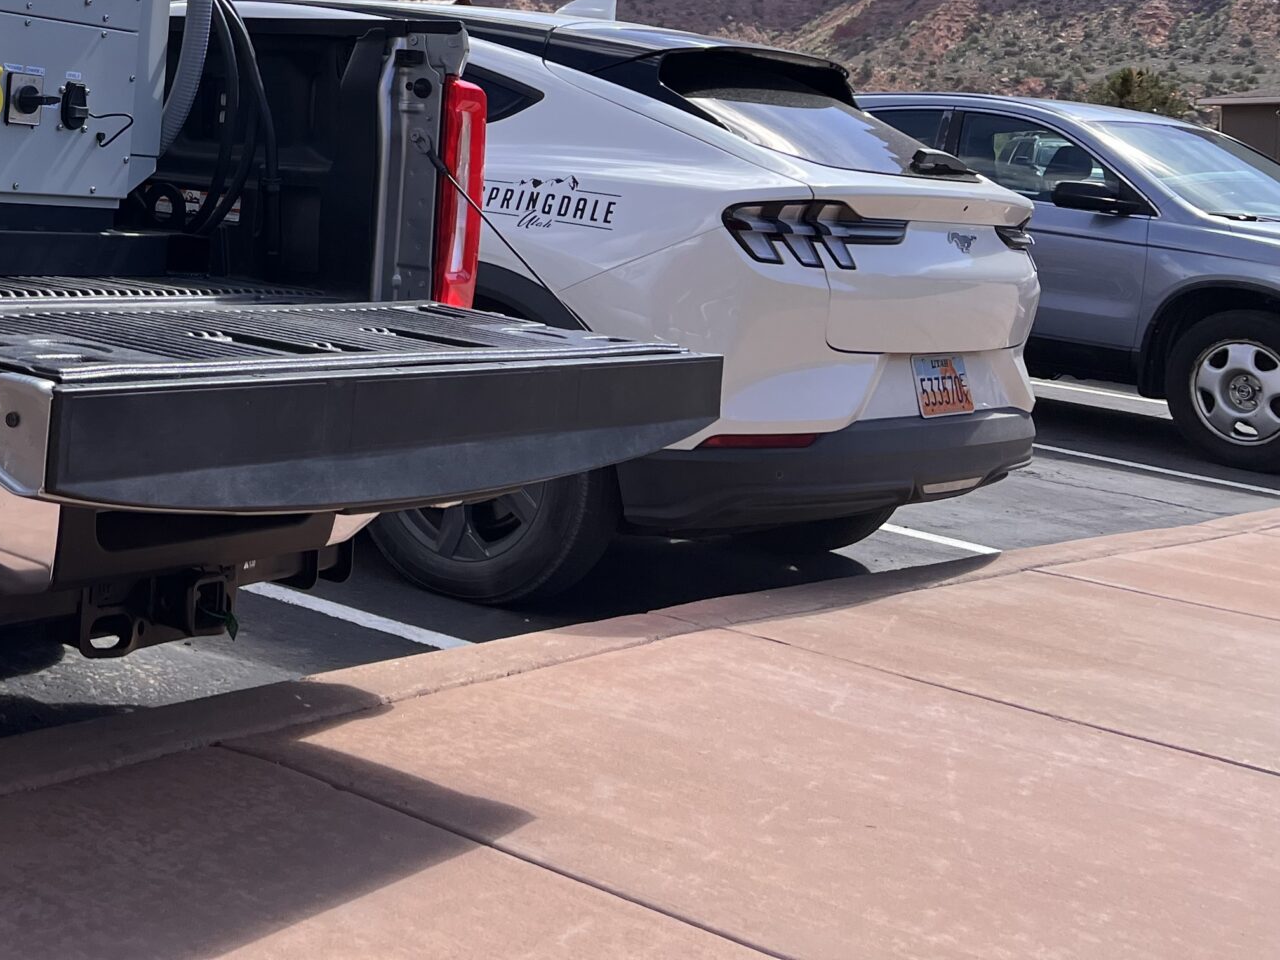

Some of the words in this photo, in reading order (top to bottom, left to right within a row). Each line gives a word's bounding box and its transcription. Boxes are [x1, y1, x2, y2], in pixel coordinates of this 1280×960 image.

[483, 186, 617, 224] PRINGDALE
[517, 209, 553, 229] Utah
[930, 359, 949, 369] UTAH
